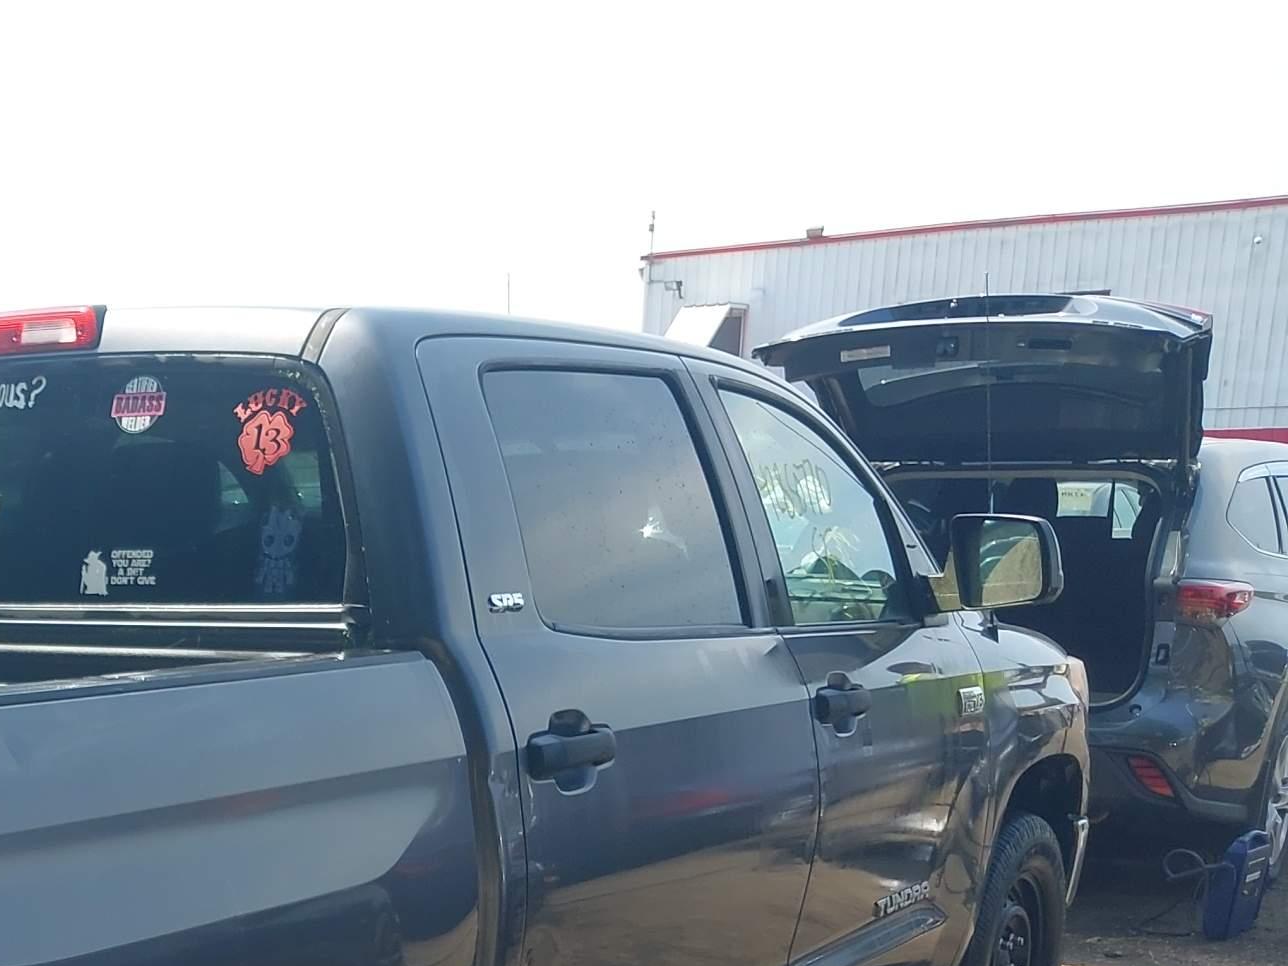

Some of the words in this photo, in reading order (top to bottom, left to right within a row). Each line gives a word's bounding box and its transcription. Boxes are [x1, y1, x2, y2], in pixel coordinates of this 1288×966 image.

[114, 394, 164, 415] BADASS
[233, 388, 307, 423] LUCKY
[253, 423, 281, 456] 13
[111, 549, 154, 559] OFFENDED
[112, 559, 129, 568] YOU
[137, 576, 157, 585] GIVE
[874, 880, 930, 918] TUNDRA
